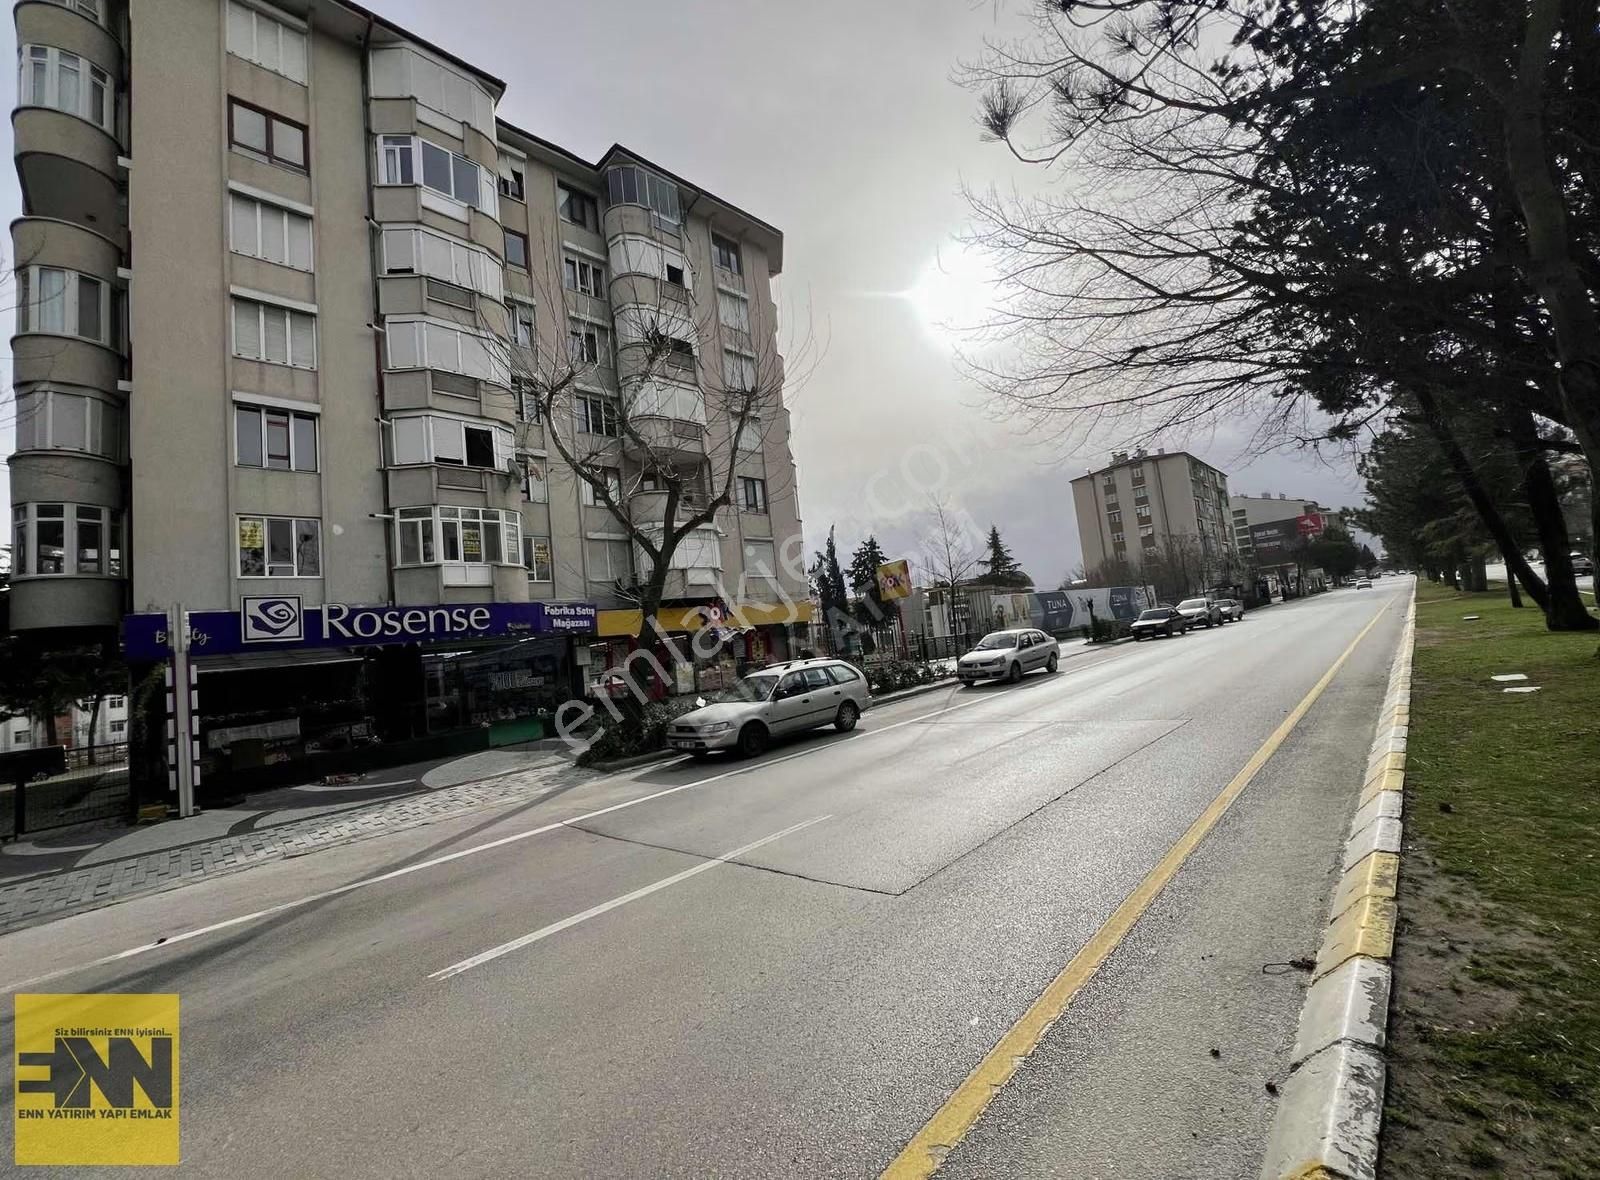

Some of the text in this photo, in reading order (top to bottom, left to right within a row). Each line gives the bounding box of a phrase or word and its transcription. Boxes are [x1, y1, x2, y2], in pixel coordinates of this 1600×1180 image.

[1048, 600, 1067, 609] TUNA
[544, 606, 595, 617] Fabrika Satış
[321, 603, 491, 638] Rosense
[553, 618, 590, 629] Mağazası
